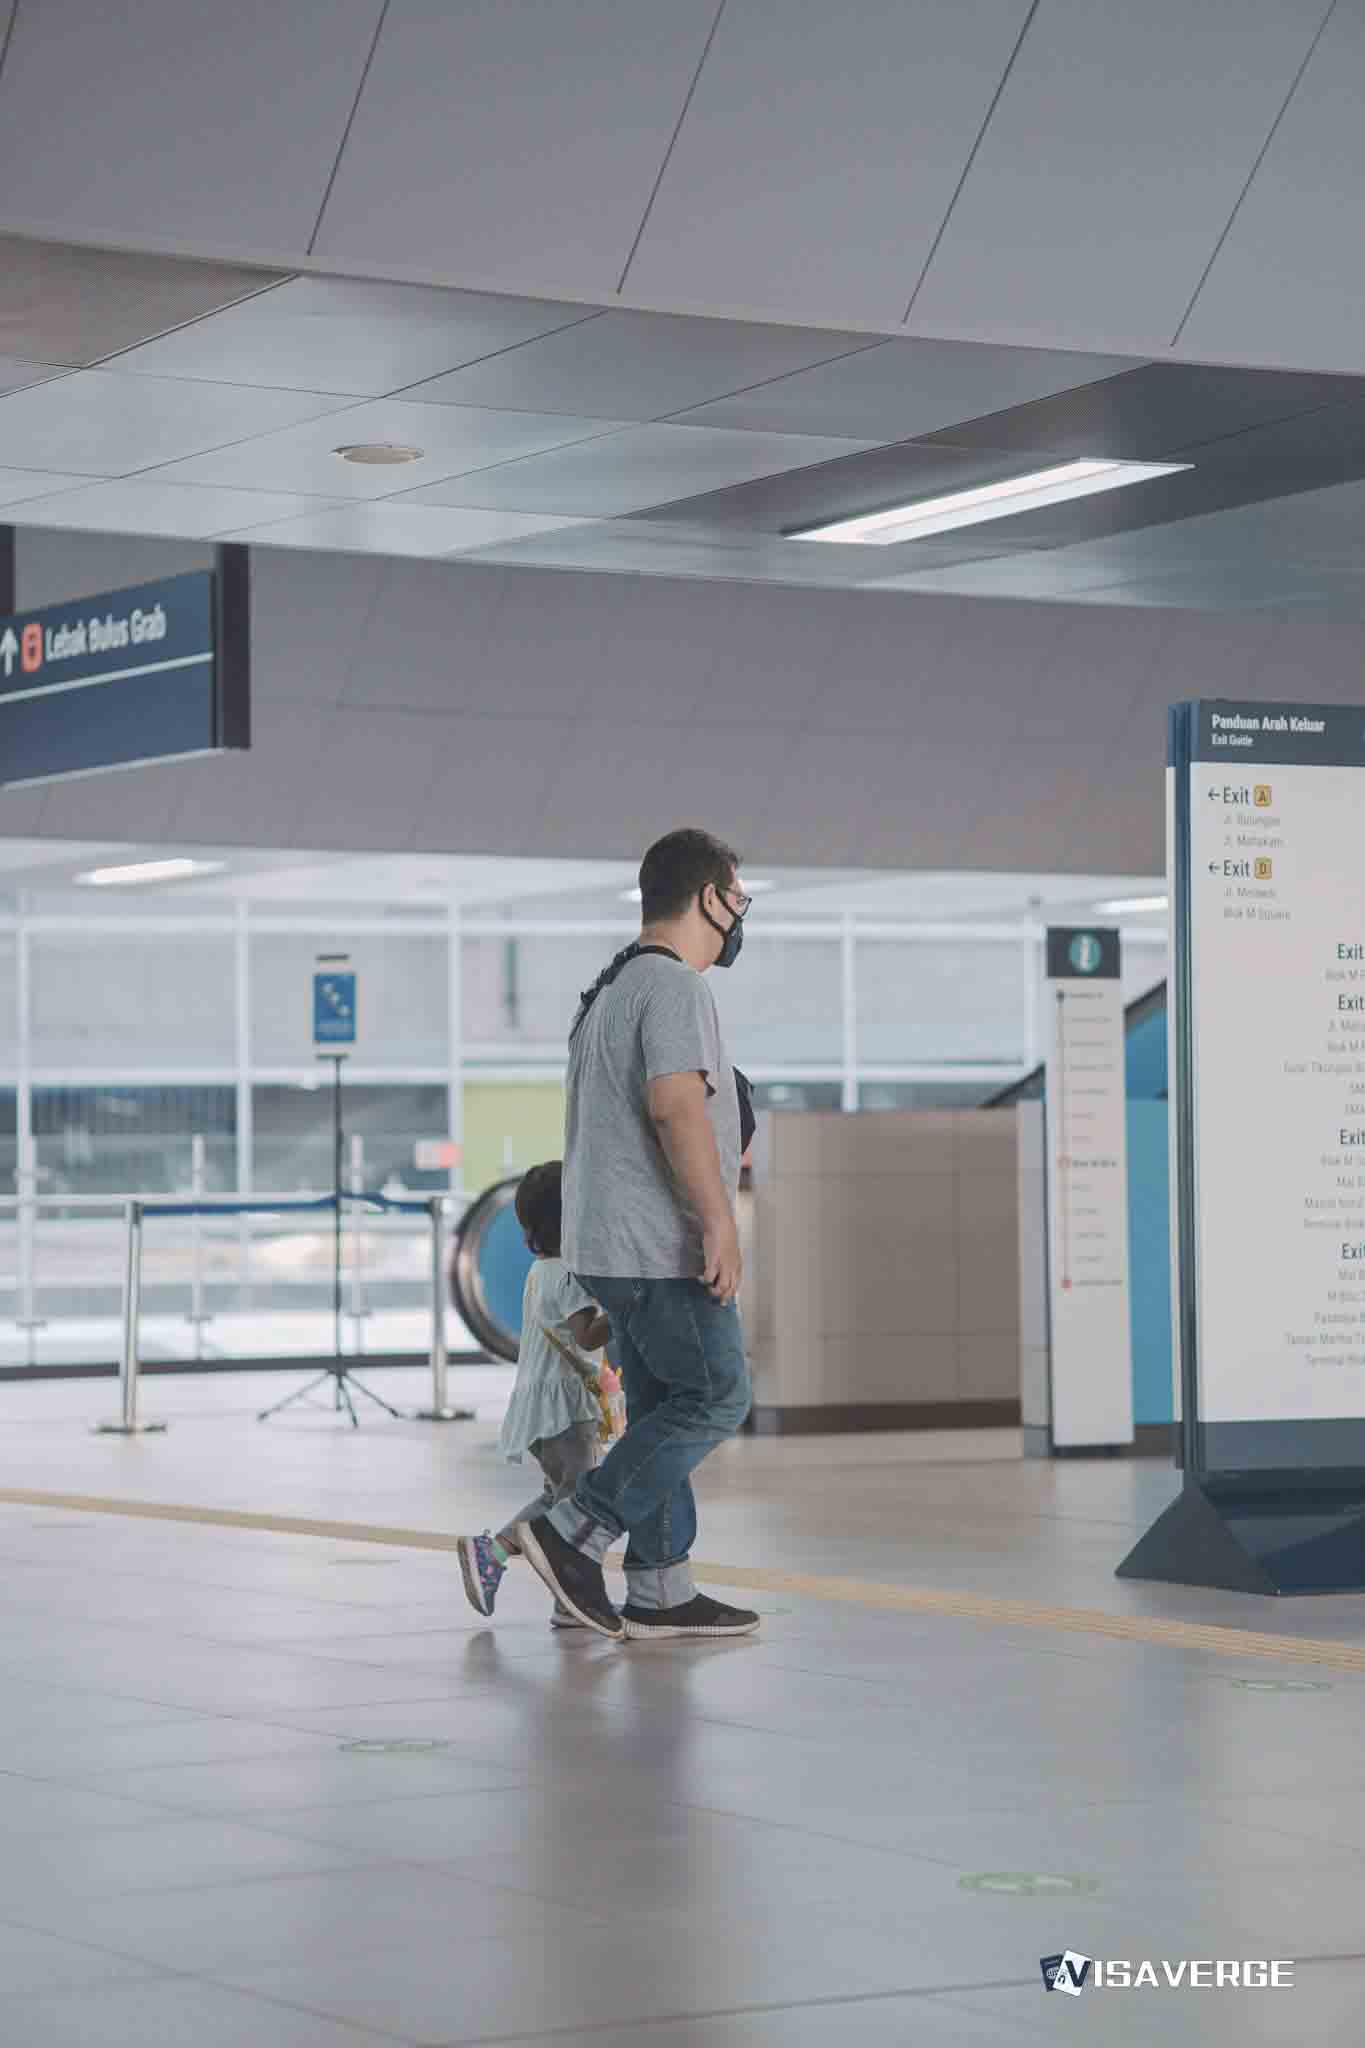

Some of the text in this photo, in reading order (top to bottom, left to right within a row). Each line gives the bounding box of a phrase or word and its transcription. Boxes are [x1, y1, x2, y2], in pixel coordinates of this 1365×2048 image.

[45, 602, 166, 662] Lebak Bulus Grab
[1211, 714, 1325, 732] Panduan Arah Keluar
[1211, 734, 1254, 747] Exit Guide
[1223, 787, 1250, 804] Exit
[1223, 859, 1250, 876] Exit
[1337, 943, 1365, 960] Exit
[1338, 994, 1365, 1011] Exit
[1340, 1128, 1365, 1145] Exit
